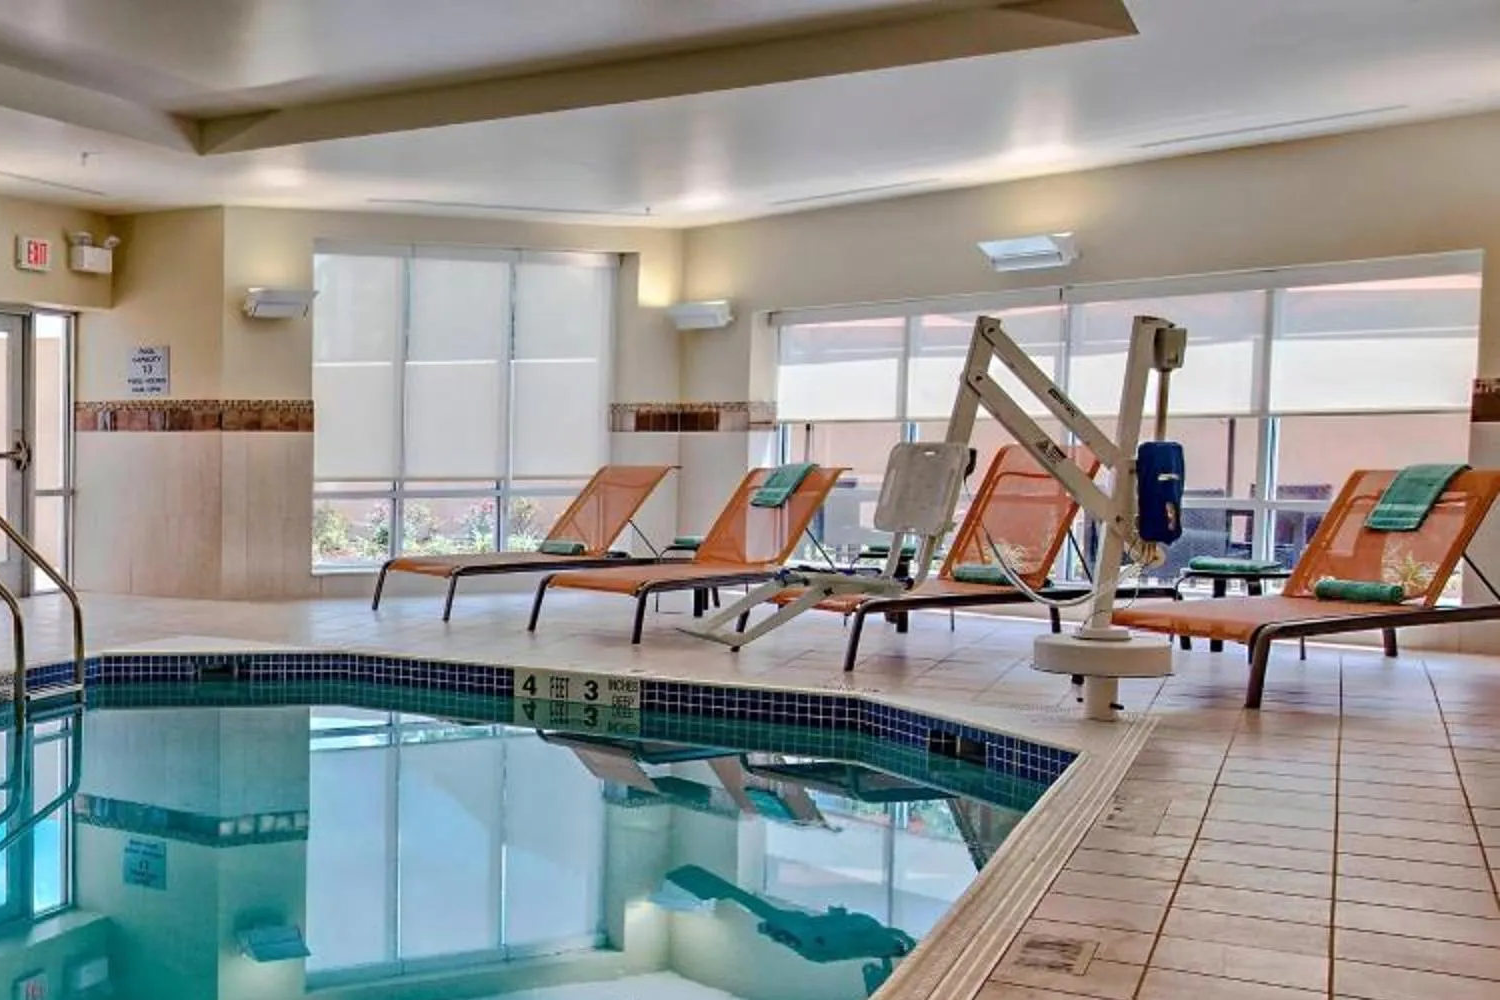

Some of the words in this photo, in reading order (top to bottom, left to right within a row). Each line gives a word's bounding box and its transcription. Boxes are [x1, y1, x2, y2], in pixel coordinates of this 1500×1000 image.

[27, 240, 47, 264] EXIT
[521, 674, 537, 696] 4
[584, 680, 599, 701] 3
